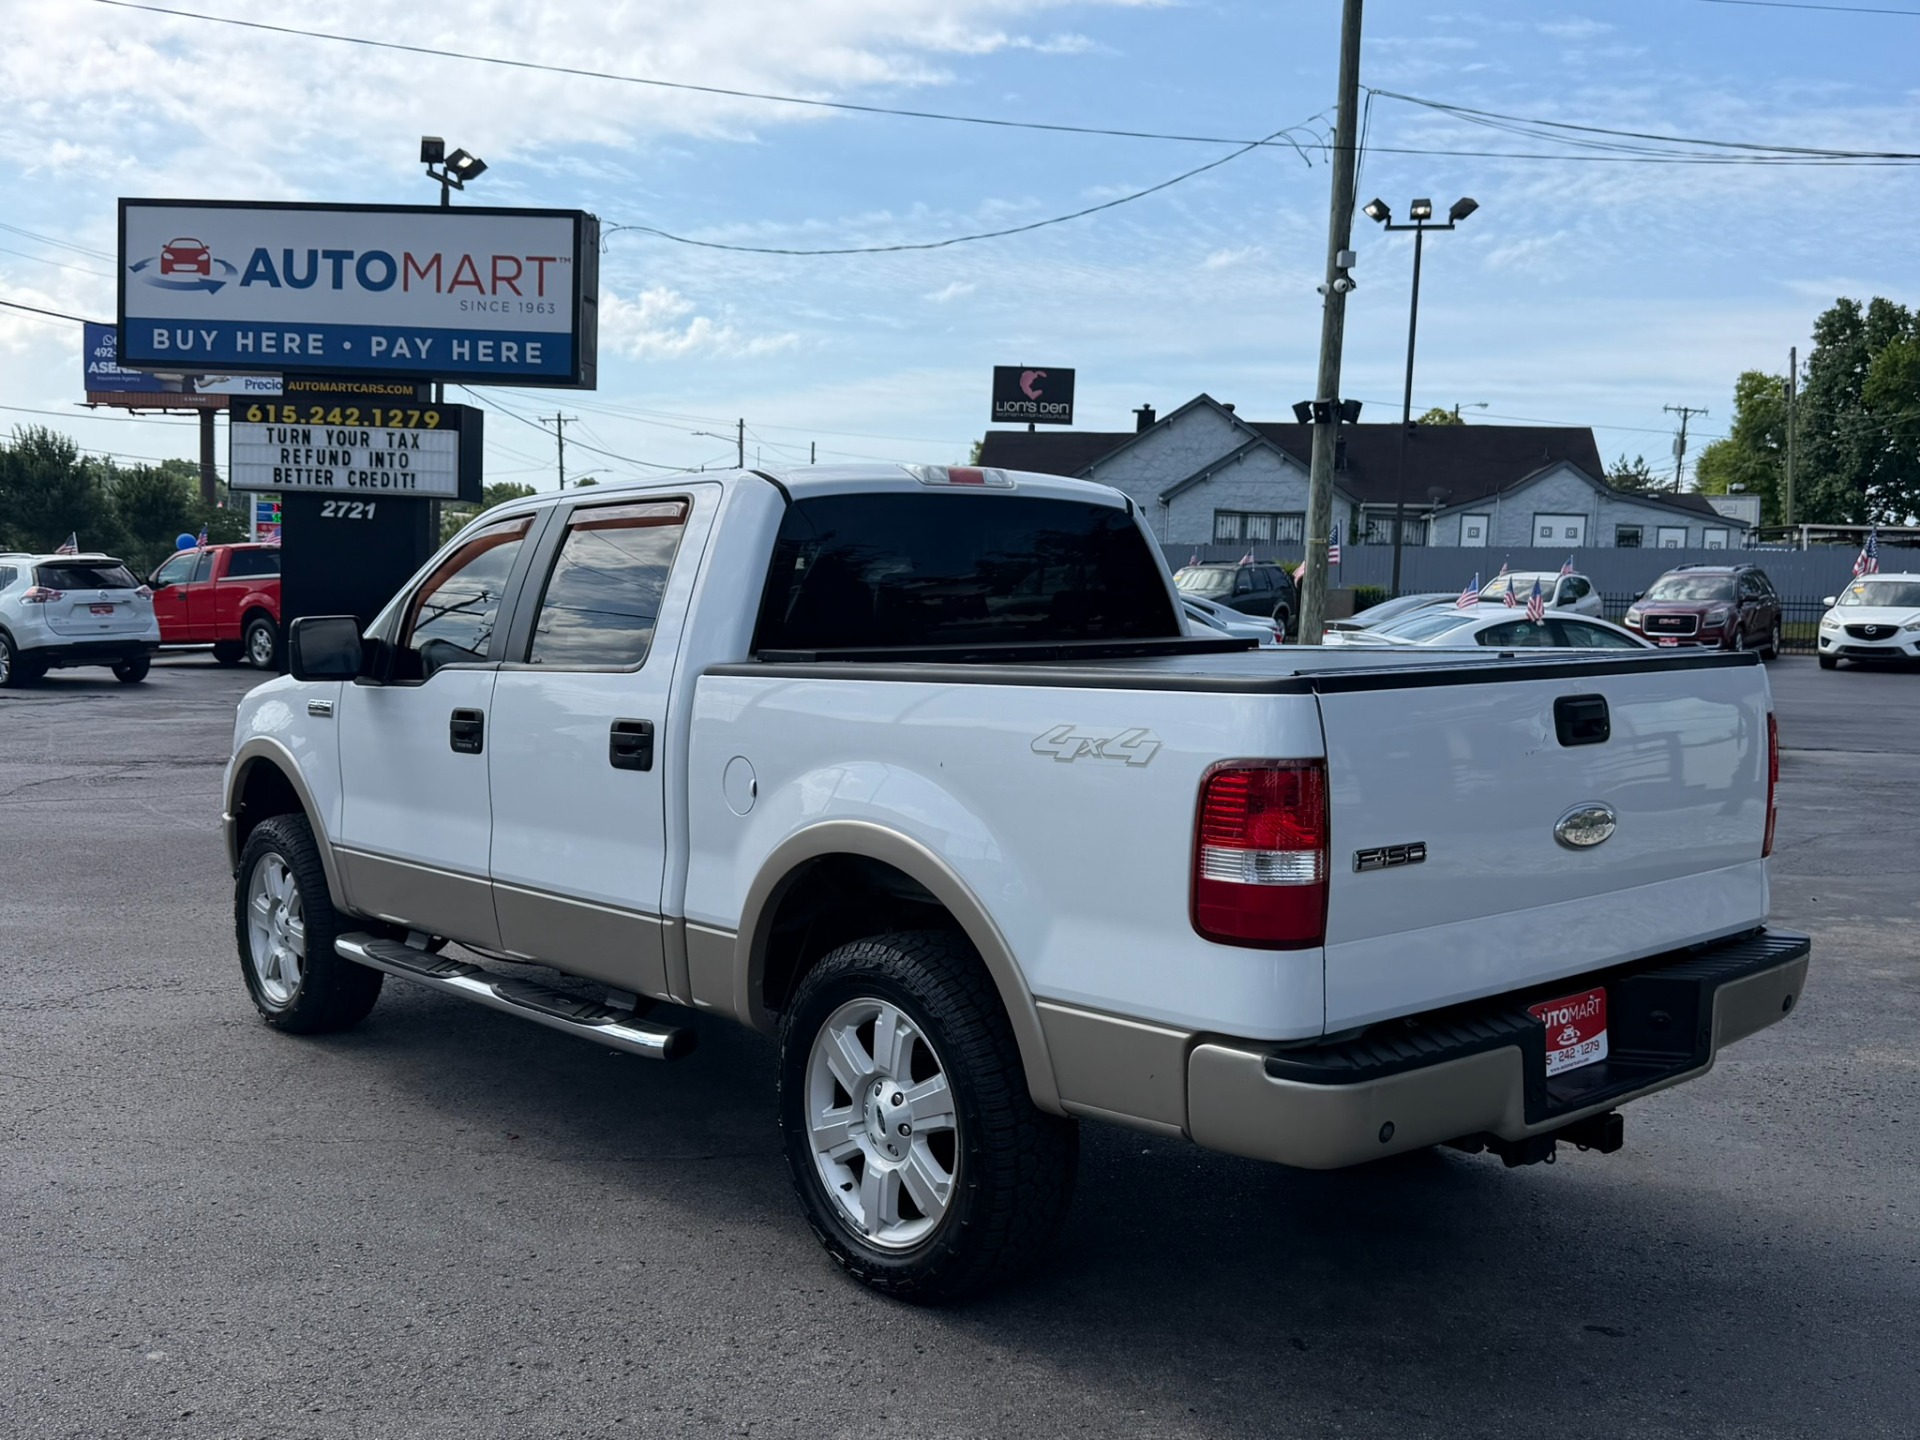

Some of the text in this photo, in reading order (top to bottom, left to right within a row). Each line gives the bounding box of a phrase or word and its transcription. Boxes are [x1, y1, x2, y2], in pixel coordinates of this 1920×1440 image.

[239, 247, 557, 297] AUTOMART
[459, 299, 556, 315] SINCE 1963
[152, 328, 543, 364] BUY HERE PAY HERE
[287, 380, 414, 396] AUTOMARTCARS.COM
[246, 404, 441, 429] 615.242.1279
[266, 427, 420, 450] TURN YOUR TAX
[280, 448, 410, 469] REFUND INTO
[273, 466, 416, 489] BETTER CREDIT!
[320, 499, 377, 520] 2721
[1537, 998, 1601, 1029] UTOMART
[1558, 1048, 1575, 1062] 242
[1580, 1040, 1600, 1055] 1279
